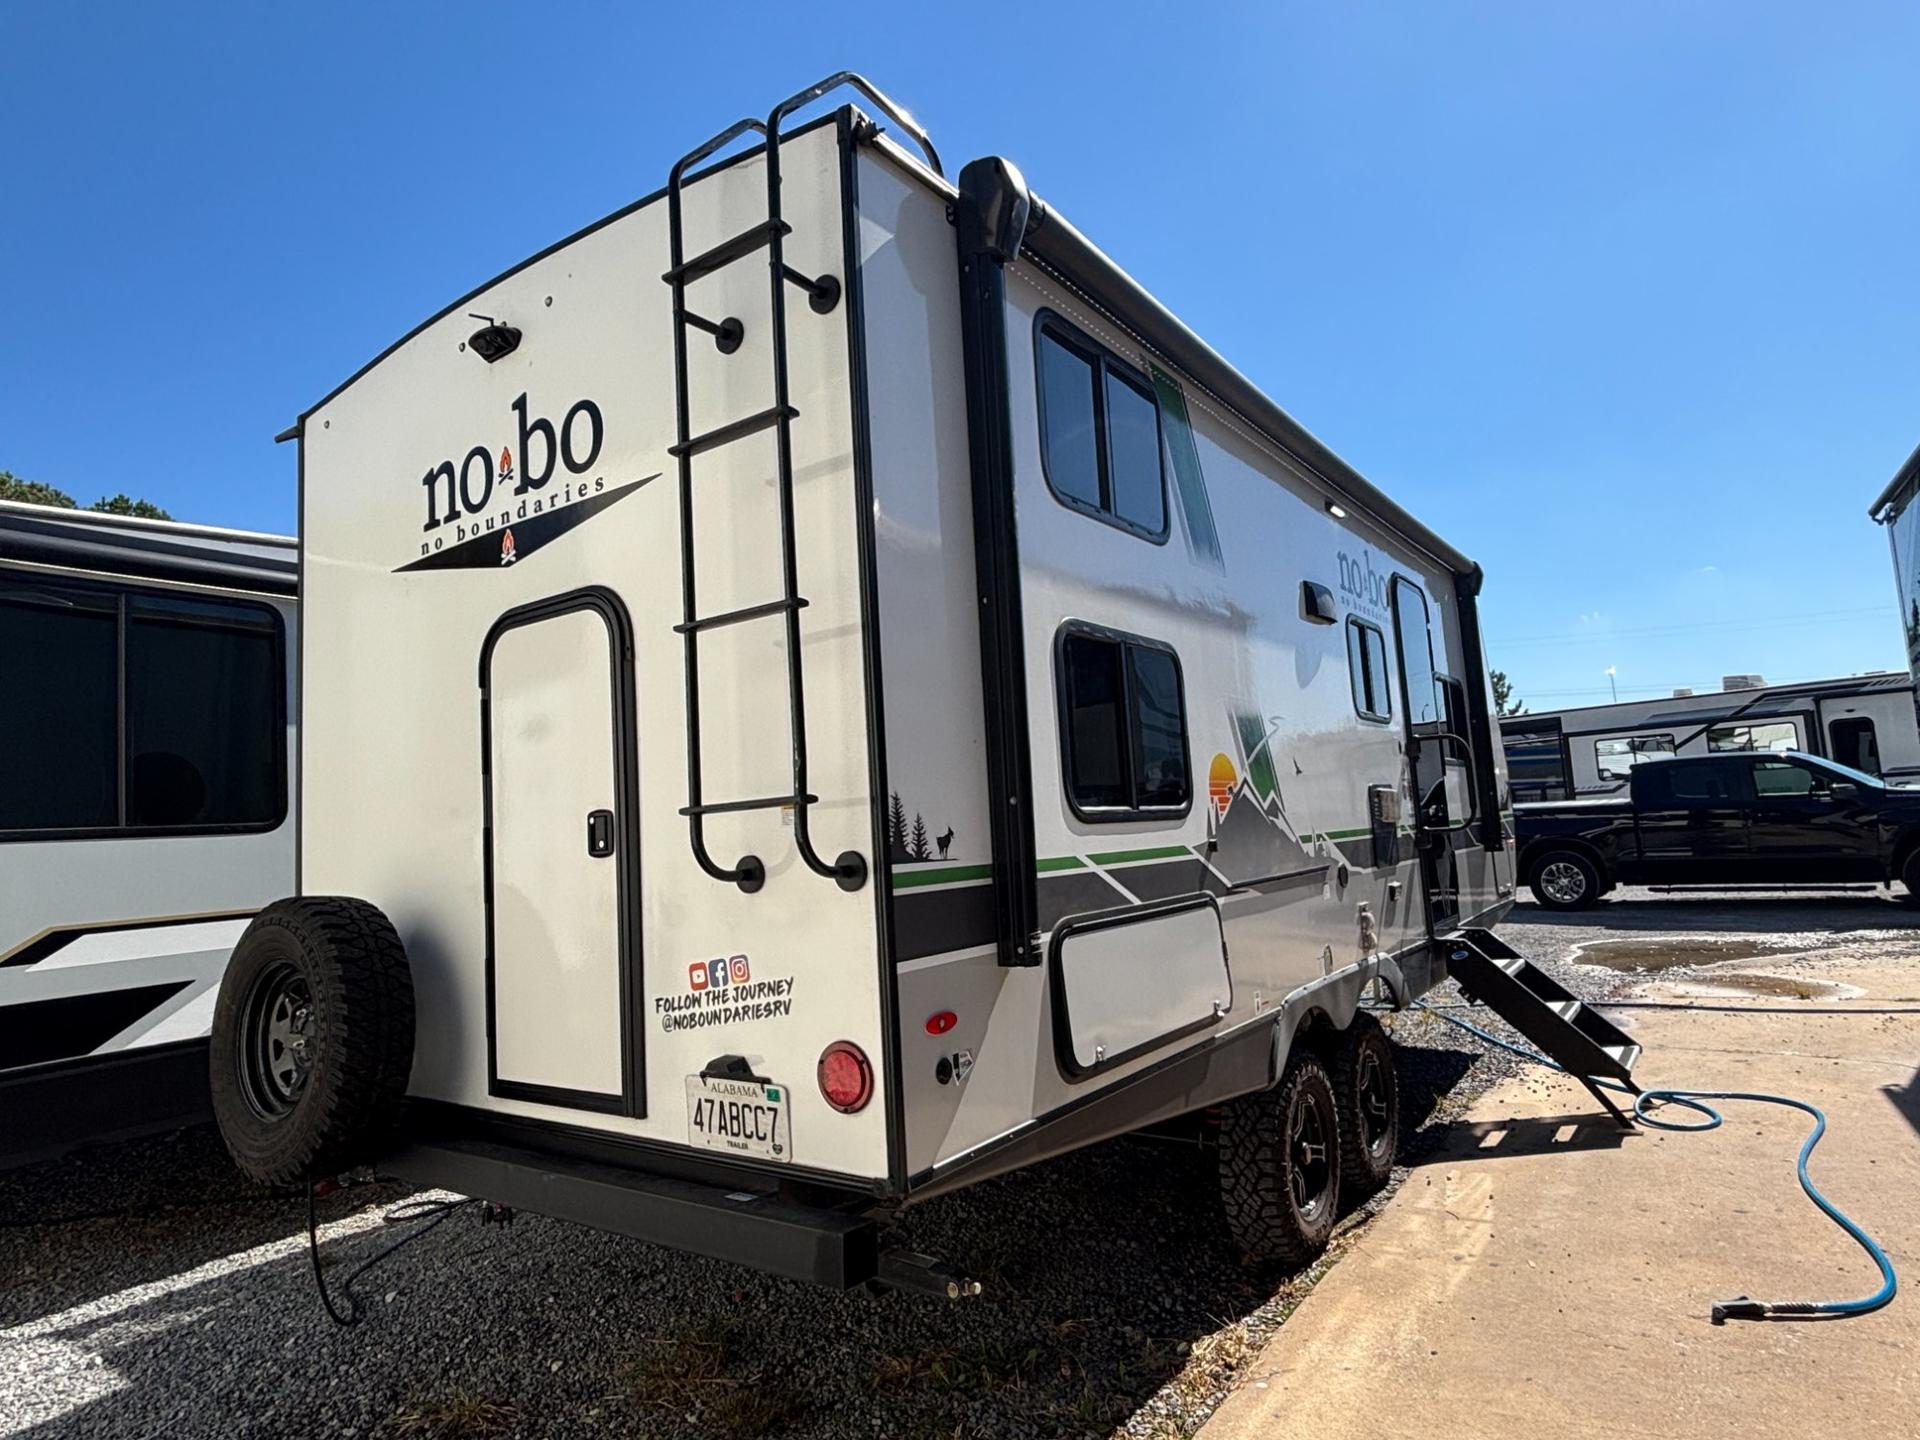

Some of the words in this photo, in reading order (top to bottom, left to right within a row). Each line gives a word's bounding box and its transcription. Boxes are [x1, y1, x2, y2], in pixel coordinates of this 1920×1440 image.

[420, 537, 443, 556] no
[456, 475, 606, 542] boundaries
[655, 992, 703, 1014] FOLLOW
[704, 987, 731, 1008] THE
[732, 976, 794, 1004] JOURNEY
[662, 998, 792, 1033] @NOBOUNDARIESRV
[711, 1083, 758, 1098] ALABAMA
[693, 1097, 778, 1143] 47ABCC7
[726, 1140, 748, 1150] TRAILER
